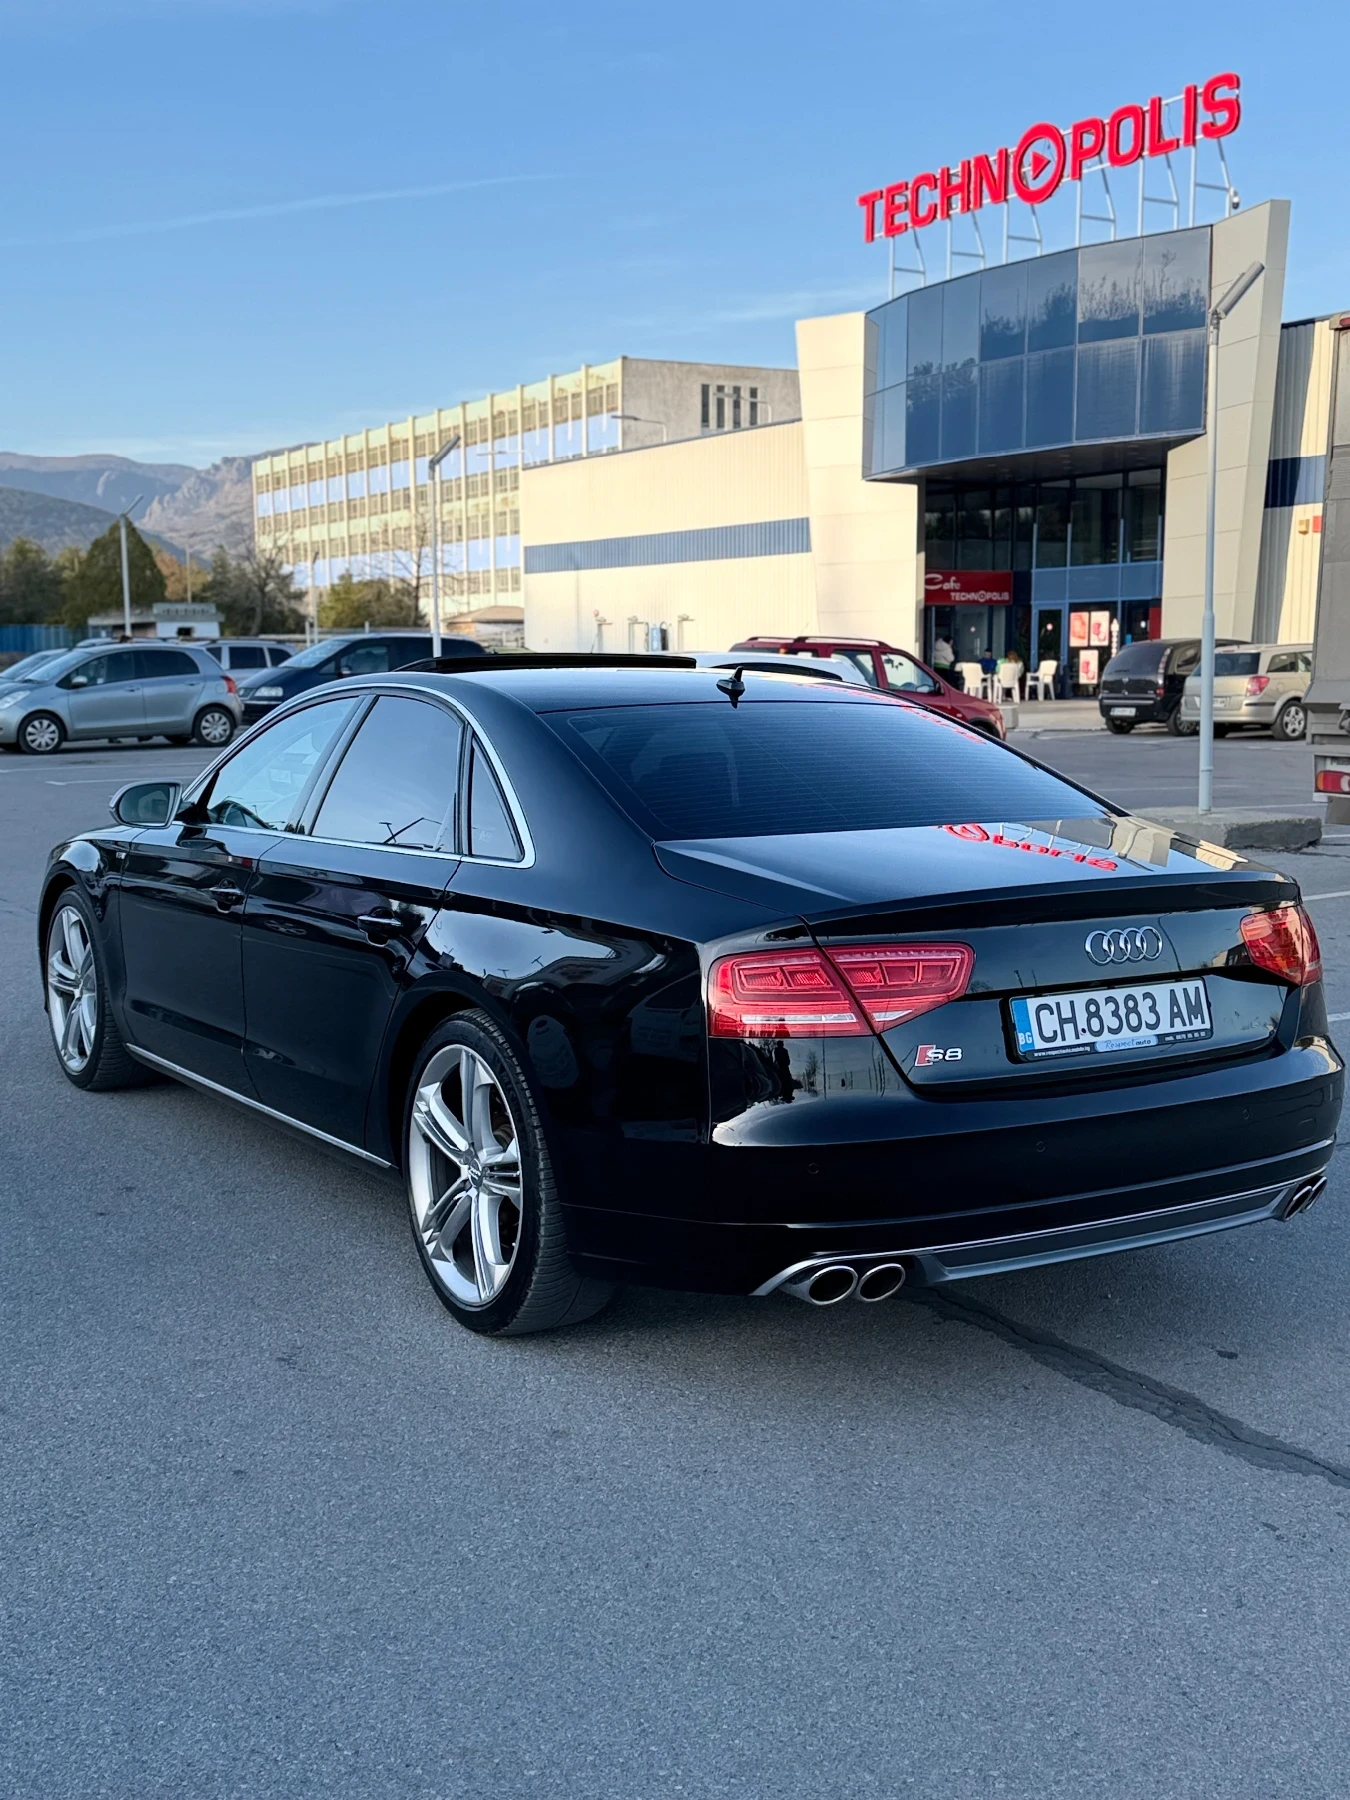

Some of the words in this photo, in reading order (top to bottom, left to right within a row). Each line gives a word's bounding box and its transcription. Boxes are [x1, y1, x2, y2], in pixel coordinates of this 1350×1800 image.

[857, 72, 1240, 243] TECHNOPOLIS
[924, 573, 961, 590] Cafe
[950, 590, 1009, 602] TECHNOPOLIS
[1085, 992, 1160, 1037] 8383
[1169, 986, 1205, 1029] AM
[1018, 1031, 1033, 1046] BG
[925, 1047, 963, 1062] S8
